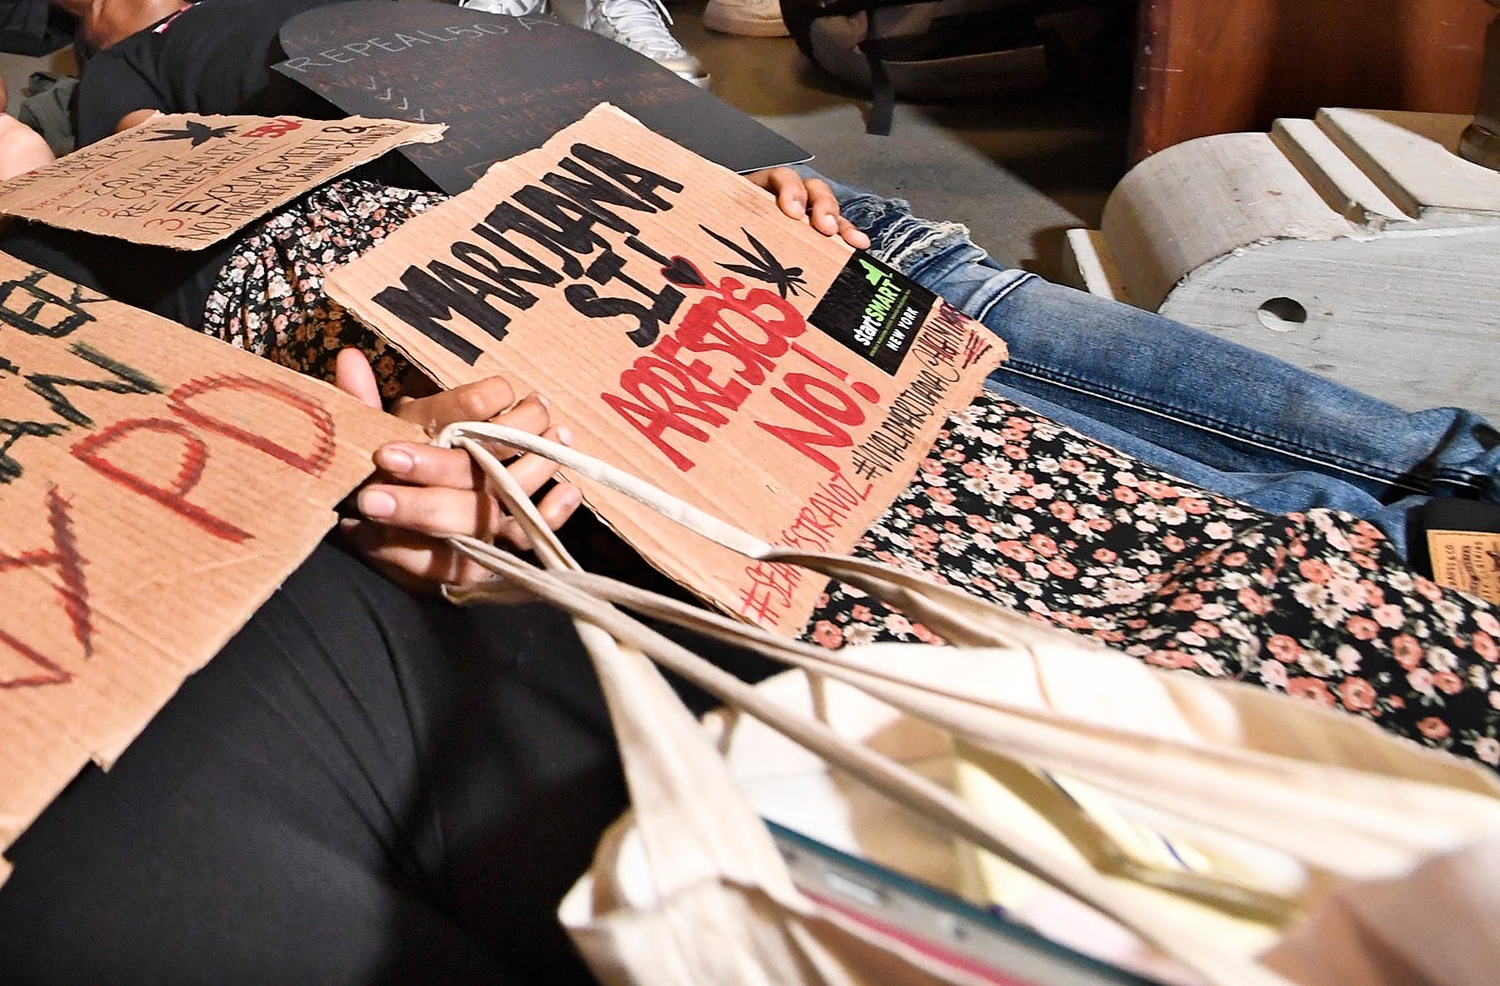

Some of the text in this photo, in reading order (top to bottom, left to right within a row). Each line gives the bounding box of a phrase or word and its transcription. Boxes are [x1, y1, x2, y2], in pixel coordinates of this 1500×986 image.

[283, 28, 458, 73] REPEAL
[112, 139, 244, 200] COMMUNITY
[174, 219, 234, 242] NO
[372, 141, 685, 367] MARIJUANA
[564, 230, 688, 348] SI
[885, 328, 907, 352] NEW
[897, 306, 920, 331] YORK
[600, 273, 807, 472] ARRESTOS
[754, 341, 881, 474] NO!
